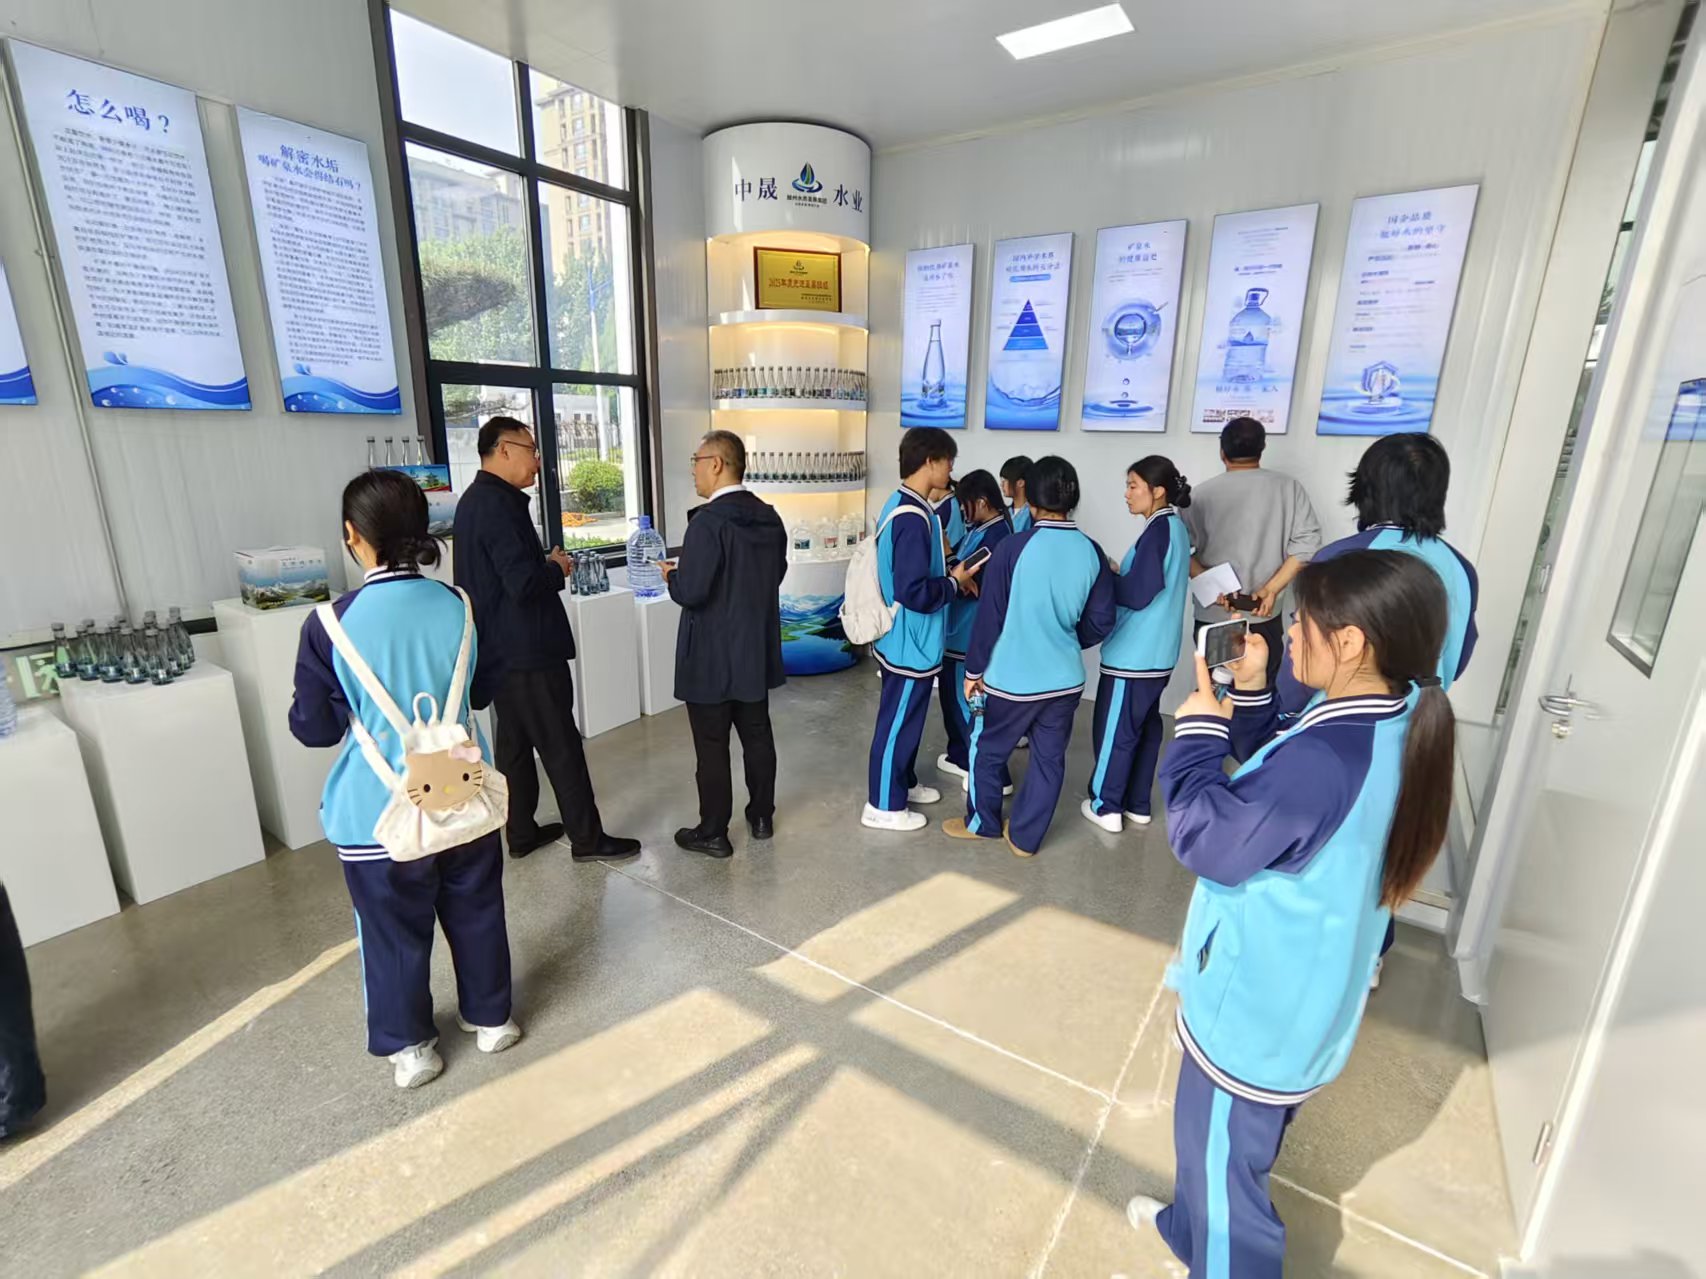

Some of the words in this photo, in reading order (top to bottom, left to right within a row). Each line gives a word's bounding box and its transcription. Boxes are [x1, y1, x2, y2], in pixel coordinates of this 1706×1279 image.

[67, 88, 170, 134] 怎么喝？
[280, 144, 339, 173] 解密水垢
[735, 177, 778, 202] 中晟
[833, 184, 863, 213] 水业
